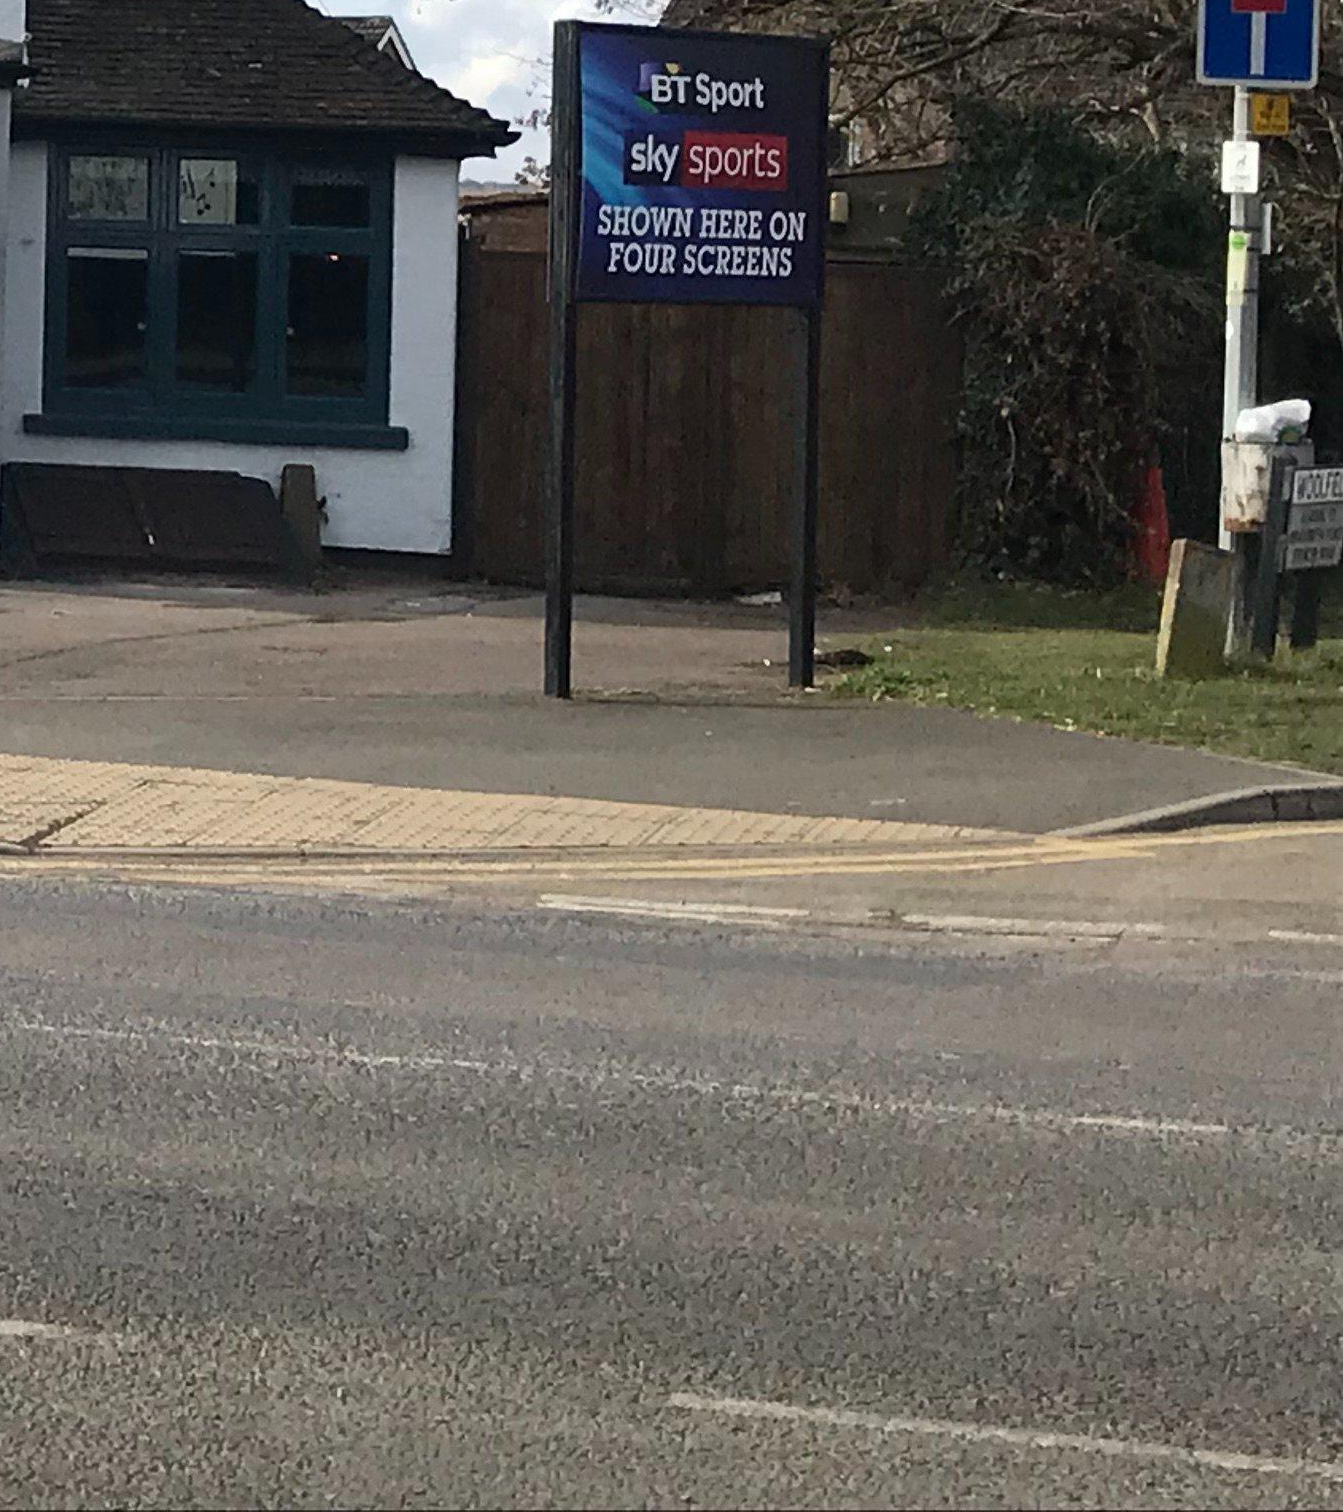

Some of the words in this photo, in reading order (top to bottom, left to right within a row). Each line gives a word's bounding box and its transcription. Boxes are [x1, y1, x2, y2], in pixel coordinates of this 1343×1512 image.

[650, 73, 691, 104] BT
[695, 72, 765, 113] Sport
[630, 134, 680, 182] sky
[688, 142, 781, 184] sports
[597, 204, 694, 238] SHOWN
[699, 208, 763, 240] HERE
[769, 211, 807, 242] ON
[607, 242, 677, 275] FOUR
[683, 246, 793, 278] SCREENS
